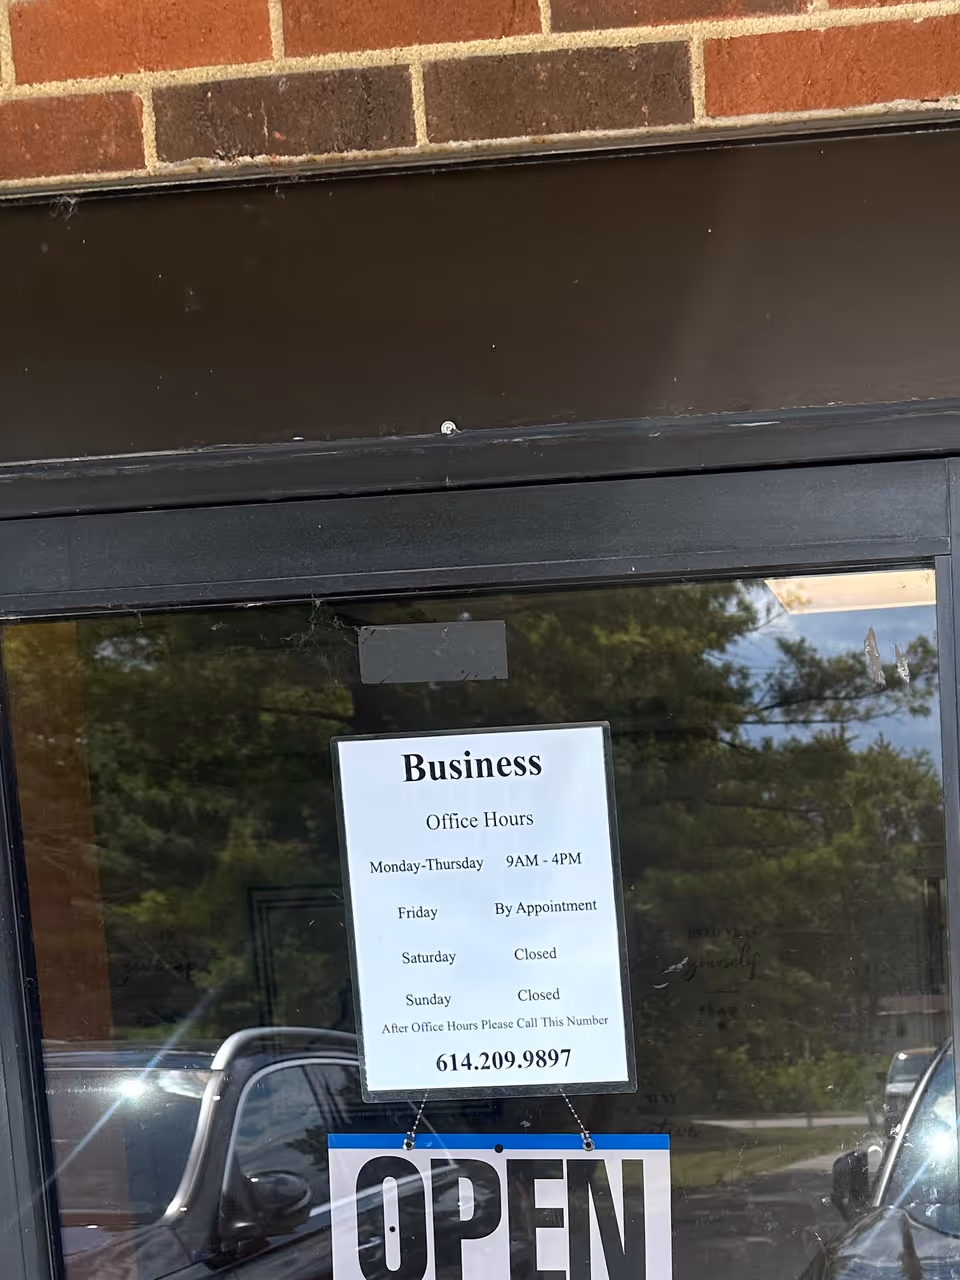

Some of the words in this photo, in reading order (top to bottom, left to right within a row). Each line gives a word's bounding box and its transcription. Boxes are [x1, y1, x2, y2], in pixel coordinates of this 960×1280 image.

[400, 750, 542, 783] Business
[425, 812, 479, 831] Office
[483, 811, 534, 828] Hours
[369, 856, 484, 875] Monday-Thursday
[505, 853, 540, 868] 9AM
[551, 851, 582, 866] 4PM
[397, 905, 438, 921] Friday
[494, 902, 513, 918] By
[515, 899, 598, 917] Appointment
[401, 949, 457, 966] Saturday
[513, 946, 557, 961] Closed
[405, 992, 452, 1008] Sunday
[517, 987, 561, 1002] Closed
[381, 1022, 409, 1035] After
[410, 1021, 445, 1033] Office
[446, 1020, 479, 1032] Hours
[480, 1019, 514, 1030] Please
[516, 1017, 538, 1029] Call
[540, 1016, 565, 1028] This
[565, 1014, 609, 1027] Number
[436, 1048, 572, 1072] 614.209.9897
